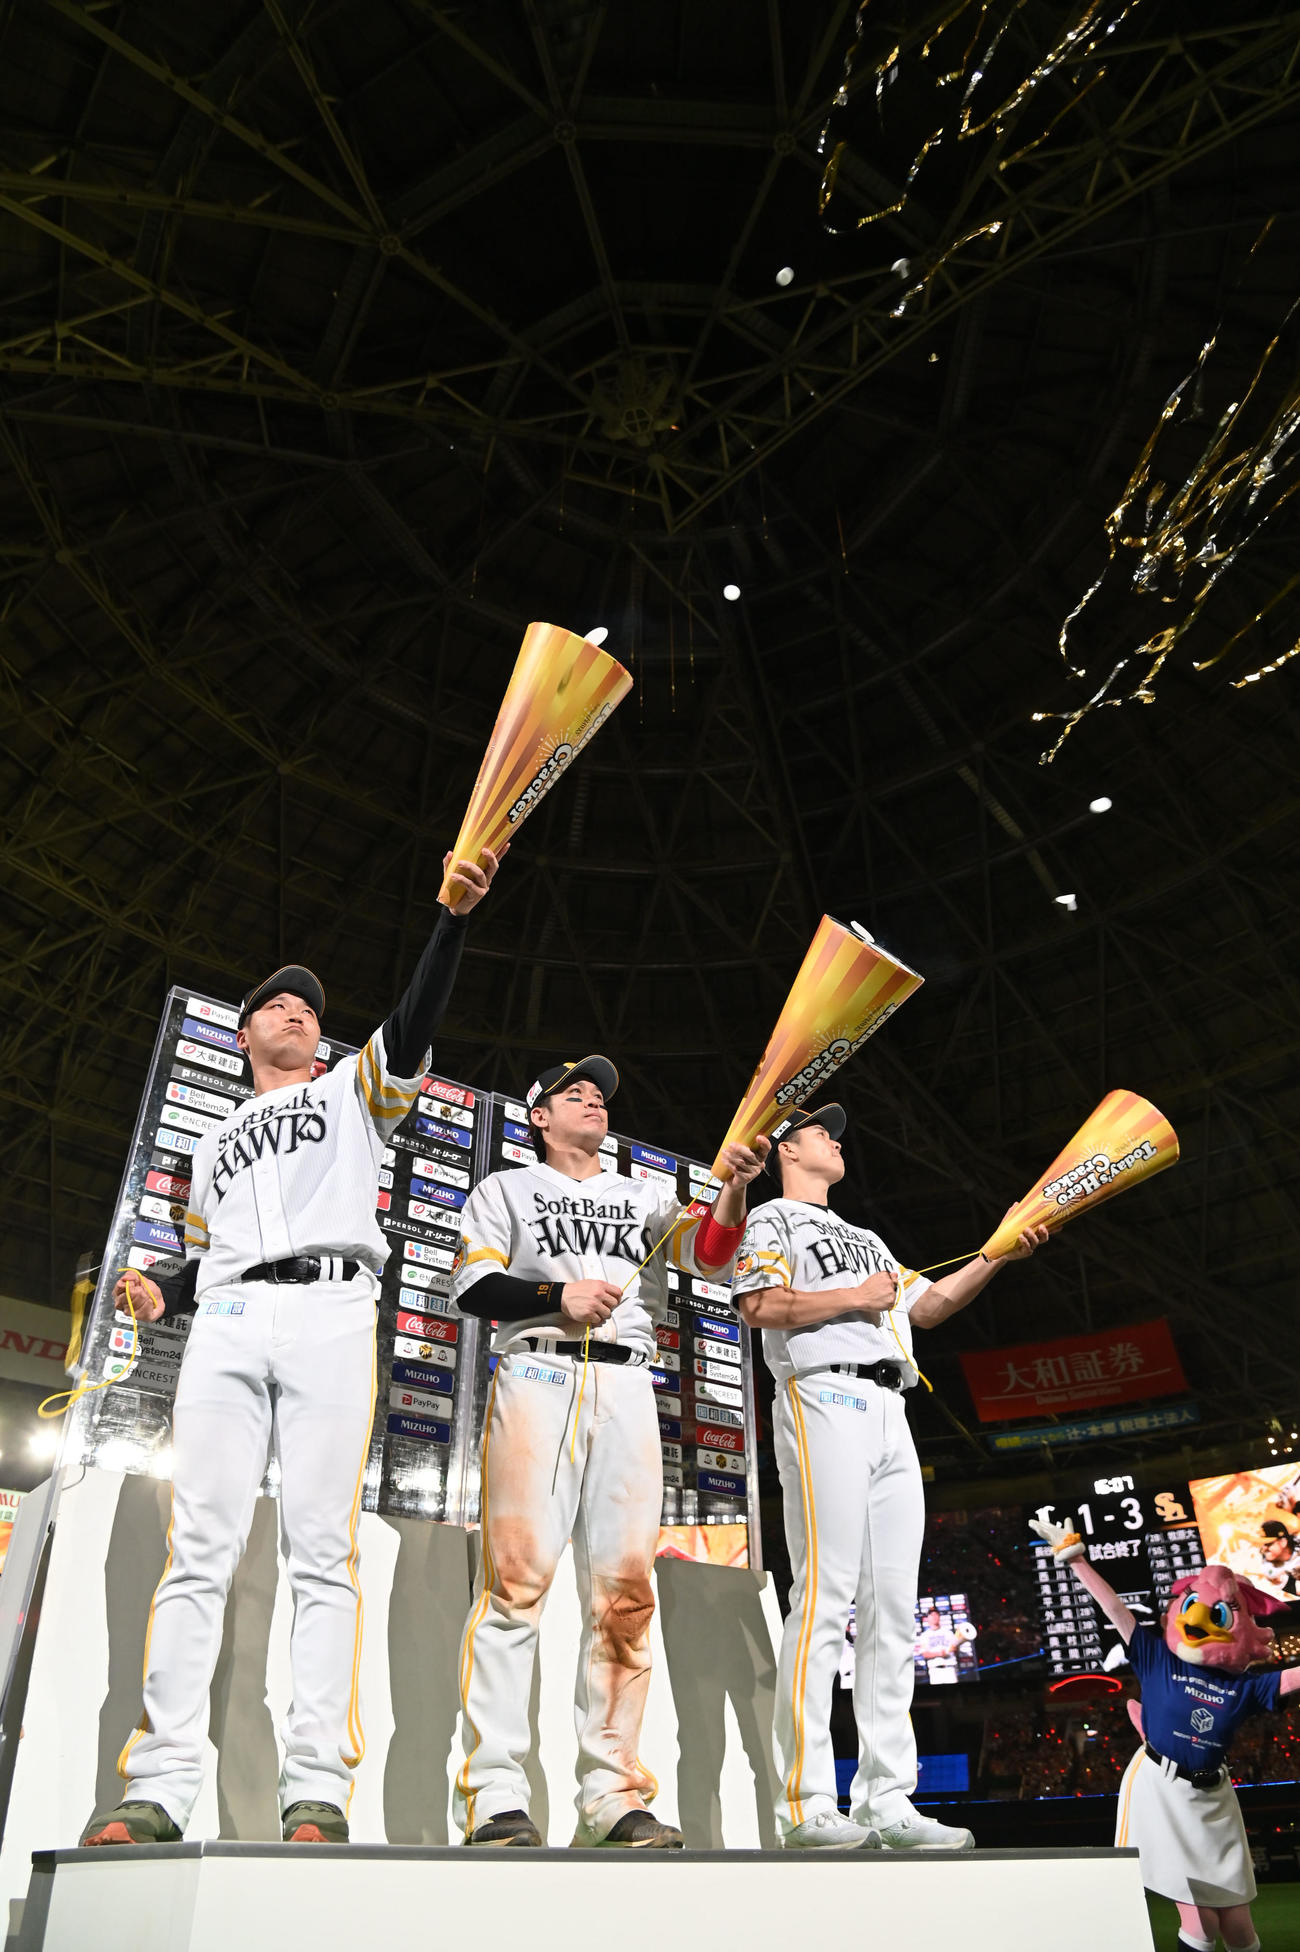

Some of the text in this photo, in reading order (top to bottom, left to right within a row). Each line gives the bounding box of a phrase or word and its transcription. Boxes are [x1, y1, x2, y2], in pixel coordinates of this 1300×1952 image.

[507, 743, 573, 824] Cracker
[196, 1025, 233, 1043] MIZUHO
[196, 1049, 239, 1071] 大東建託
[191, 1071, 224, 1087] PERSOL
[775, 1038, 852, 1105] Cracker
[190, 1089, 205, 1100] Bell
[428, 1082, 466, 1102] Coca-Cola
[188, 1097, 229, 1114] System24
[427, 1123, 459, 1138] MIZUHO
[212, 1100, 328, 1205] HAWKS
[432, 1147, 461, 1161] パ・リーグ
[641, 1150, 667, 1165] MIZUHO
[1099, 1140, 1157, 1184] Today's
[1042, 1153, 1110, 1198] Cracker
[423, 1184, 455, 1200] MIZUHO
[1056, 1172, 1101, 1205] Hero
[534, 1192, 637, 1220] SoftBank
[392, 1220, 455, 1242] PERSOL パ・リーグ
[522, 1215, 653, 1267] HAWKS
[424, 1247, 437, 1256] Bell
[406, 1316, 449, 1338] Coca-Cola
[702, 1321, 729, 1334] MIZUHO
[137, 1335, 154, 1347] Bell
[405, 1369, 440, 1384] MIZUHO
[709, 1369, 738, 1381] System24
[996, 1343, 1145, 1393] 大和証券
[413, 1397, 440, 1410] PayPay
[401, 1420, 437, 1434] MIZUHO
[703, 1430, 736, 1448] Coca-Cola
[708, 1477, 736, 1489] MIZUHO
[1078, 1504, 1094, 1535] 1
[1120, 1497, 1144, 1530] 3
[1088, 1539, 1141, 1560] 試合終了
[1184, 1686, 1224, 1704] MIZUHO
